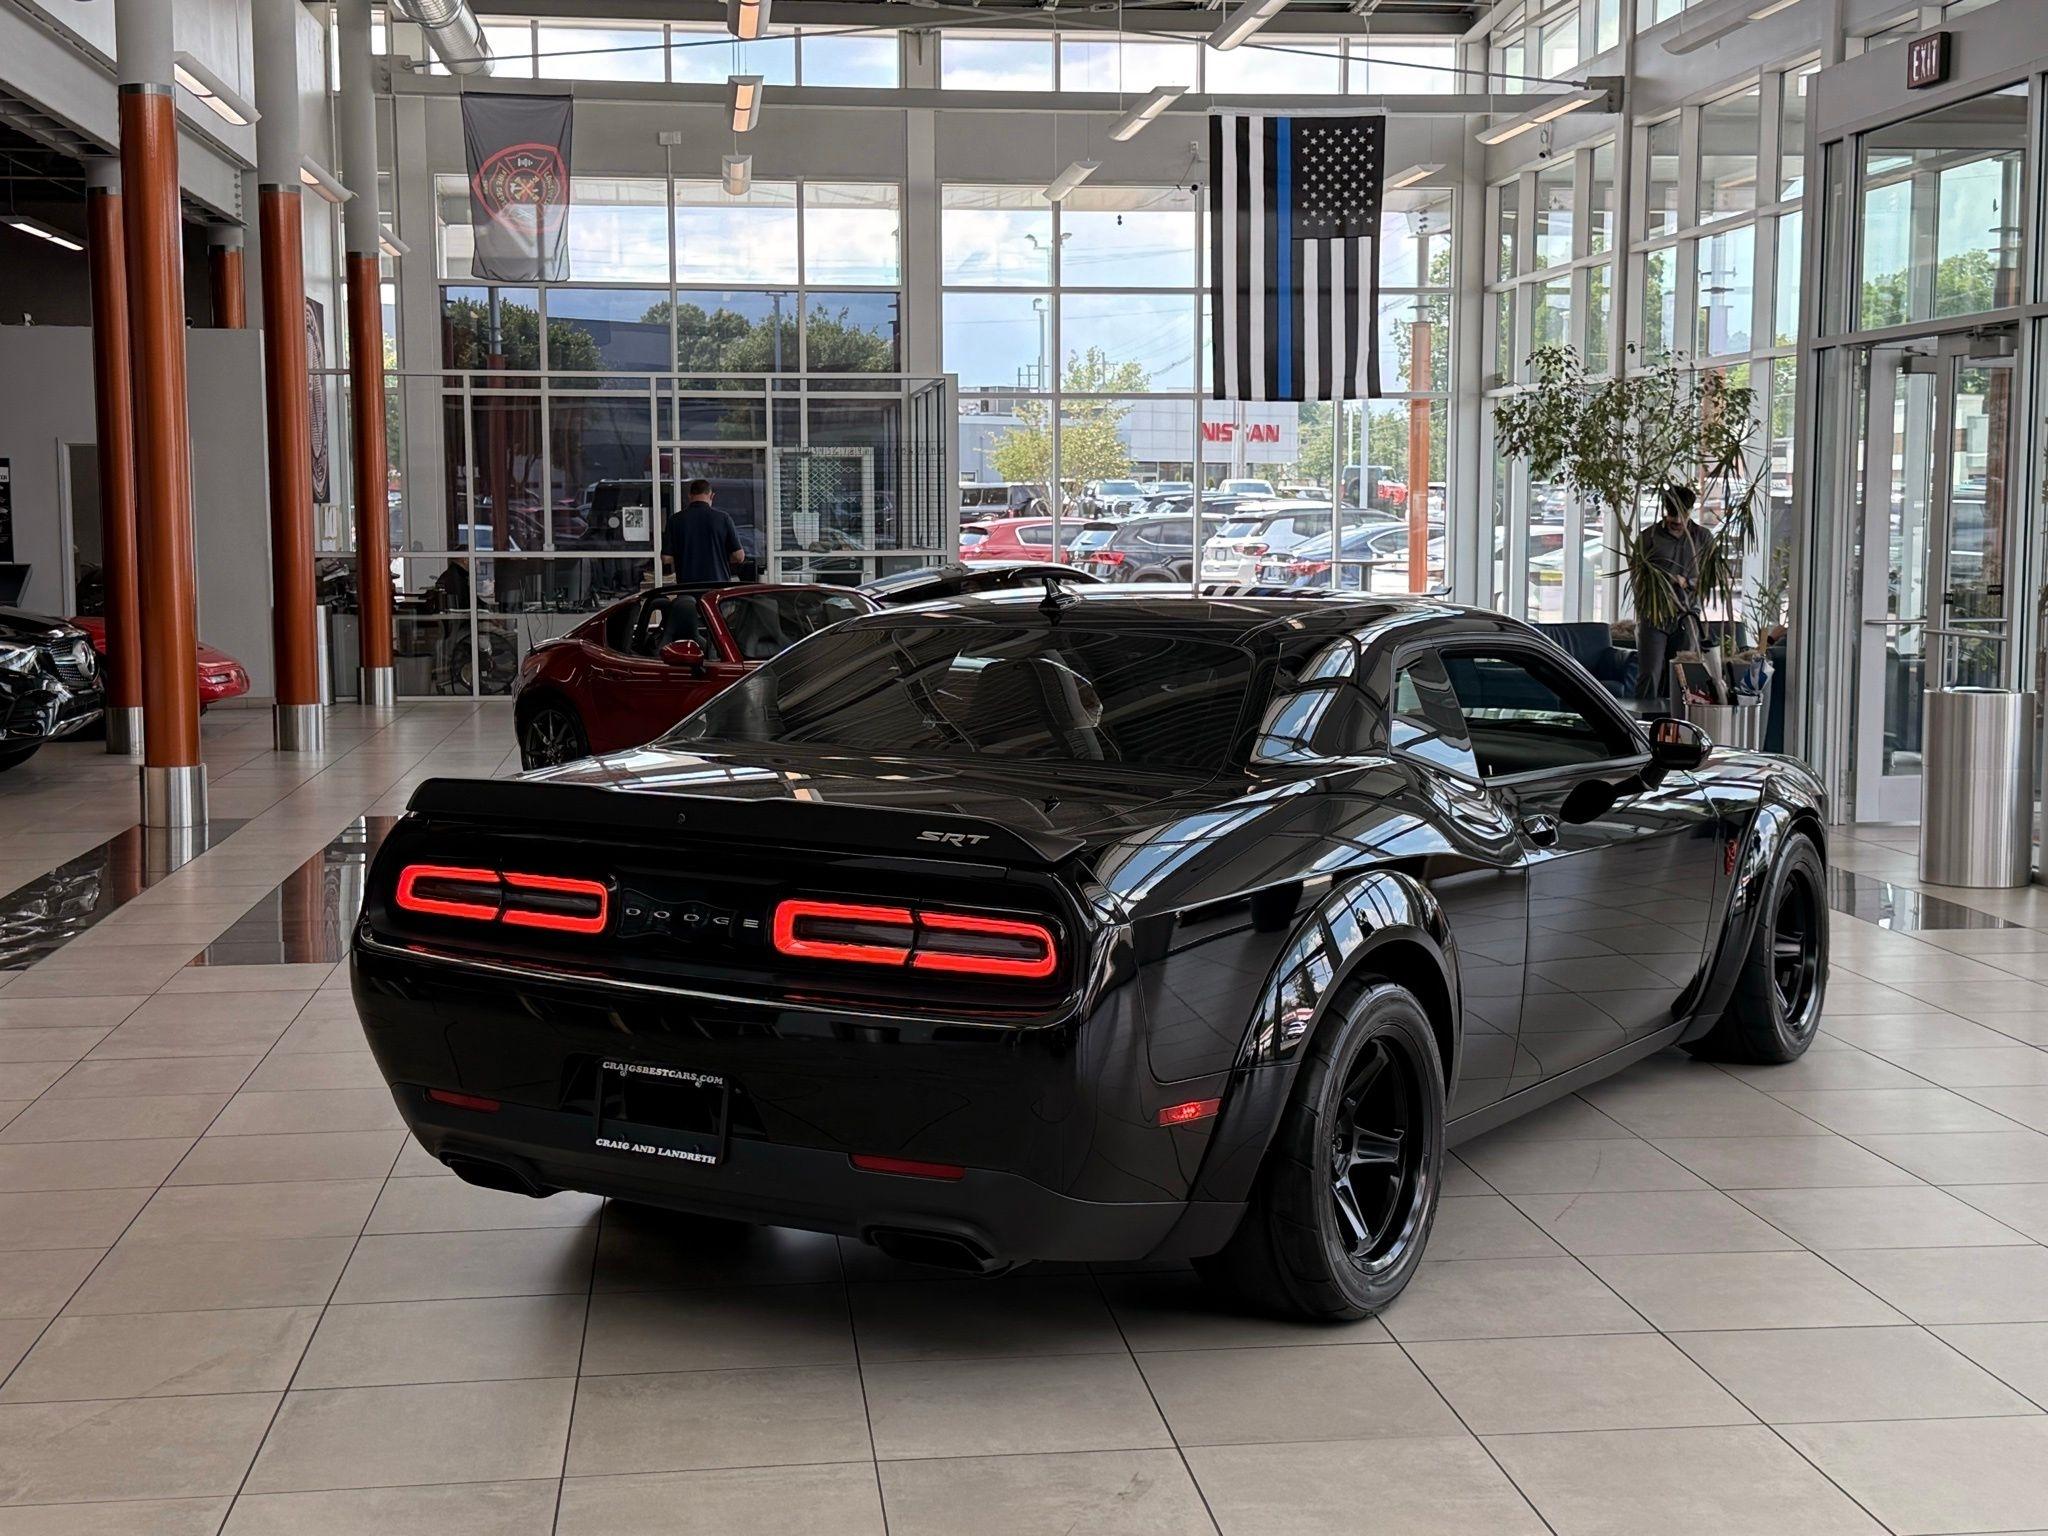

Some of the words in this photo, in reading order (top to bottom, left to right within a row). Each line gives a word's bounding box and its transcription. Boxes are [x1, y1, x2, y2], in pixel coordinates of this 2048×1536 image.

[1913, 40, 1938, 81] EXIT
[1201, 422, 1280, 442] NISAN
[916, 831, 990, 847] SRT
[625, 907, 759, 929] DODGE
[602, 1061, 723, 1085] CRAIGSBESTCARS.COM
[595, 1138, 630, 1150] CRAIG
[631, 1144, 656, 1154] AND
[657, 1147, 716, 1165] LANDRETH
